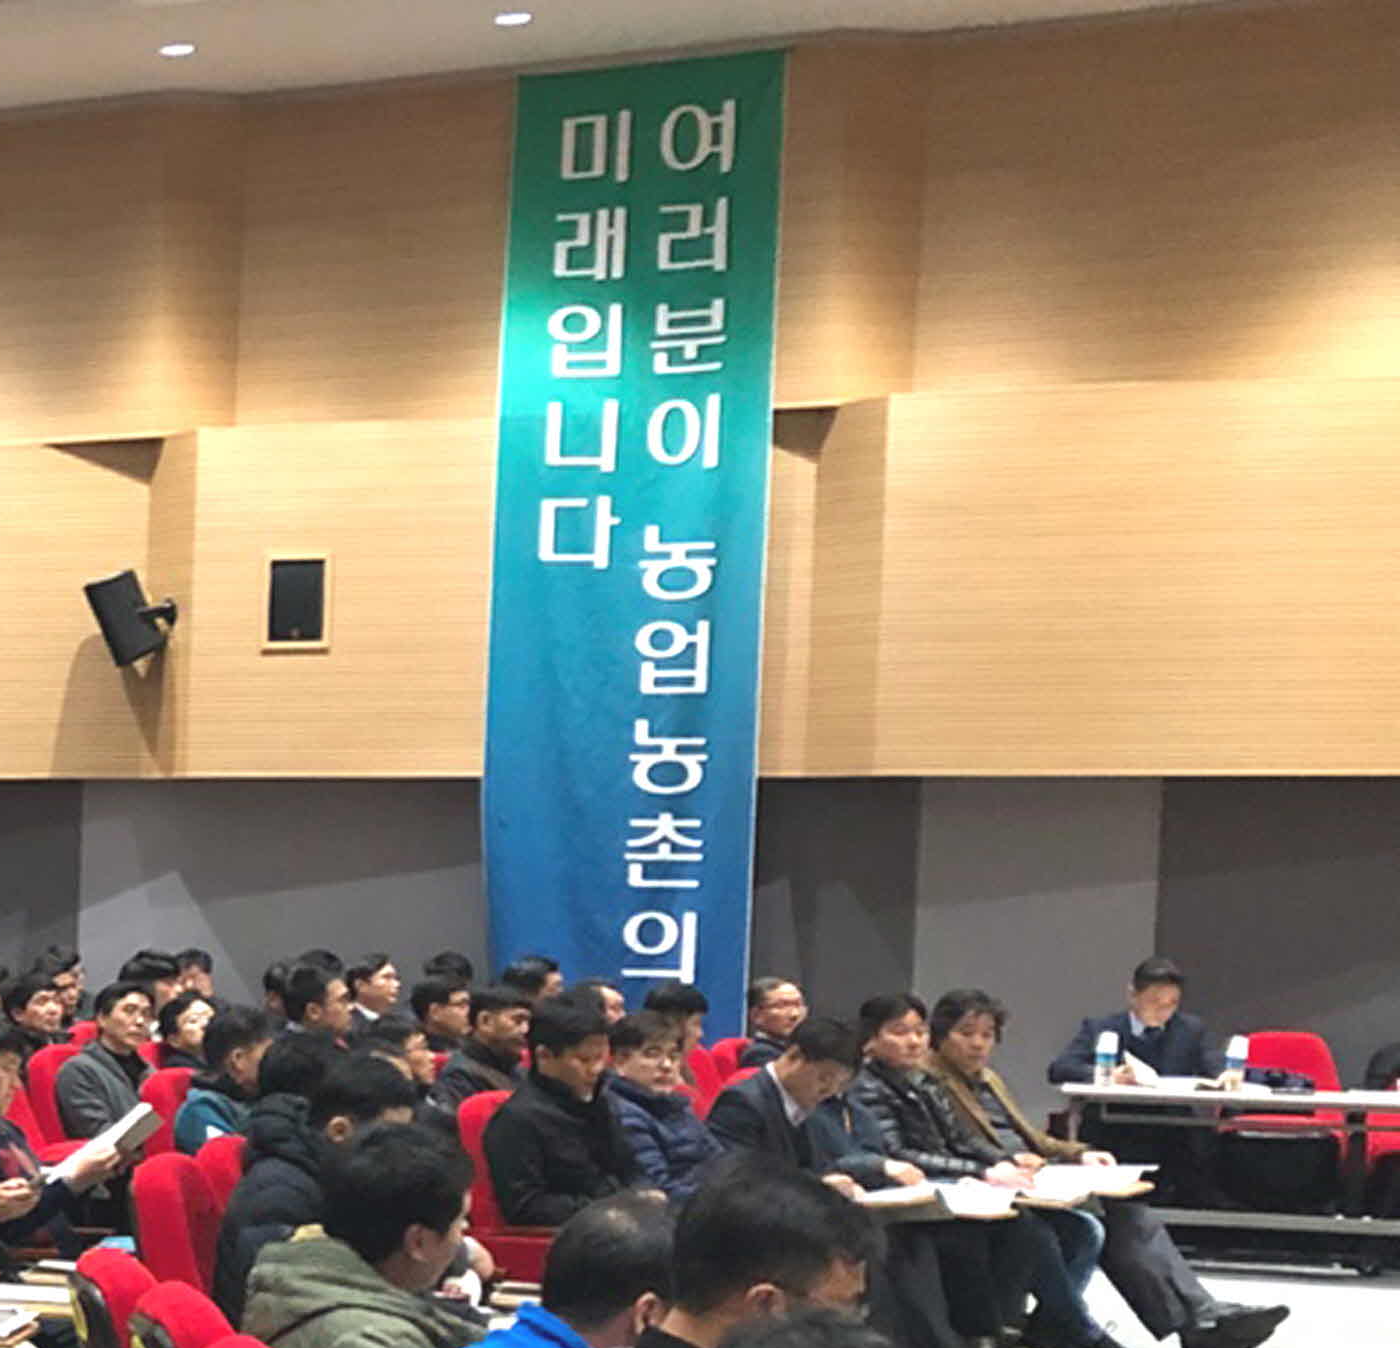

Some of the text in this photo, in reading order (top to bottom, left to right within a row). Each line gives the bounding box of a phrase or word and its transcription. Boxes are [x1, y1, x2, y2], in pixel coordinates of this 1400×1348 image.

[537, 110, 632, 571] 미래입니다
[621, 100, 736, 985] 여러분이 농업농촌의
